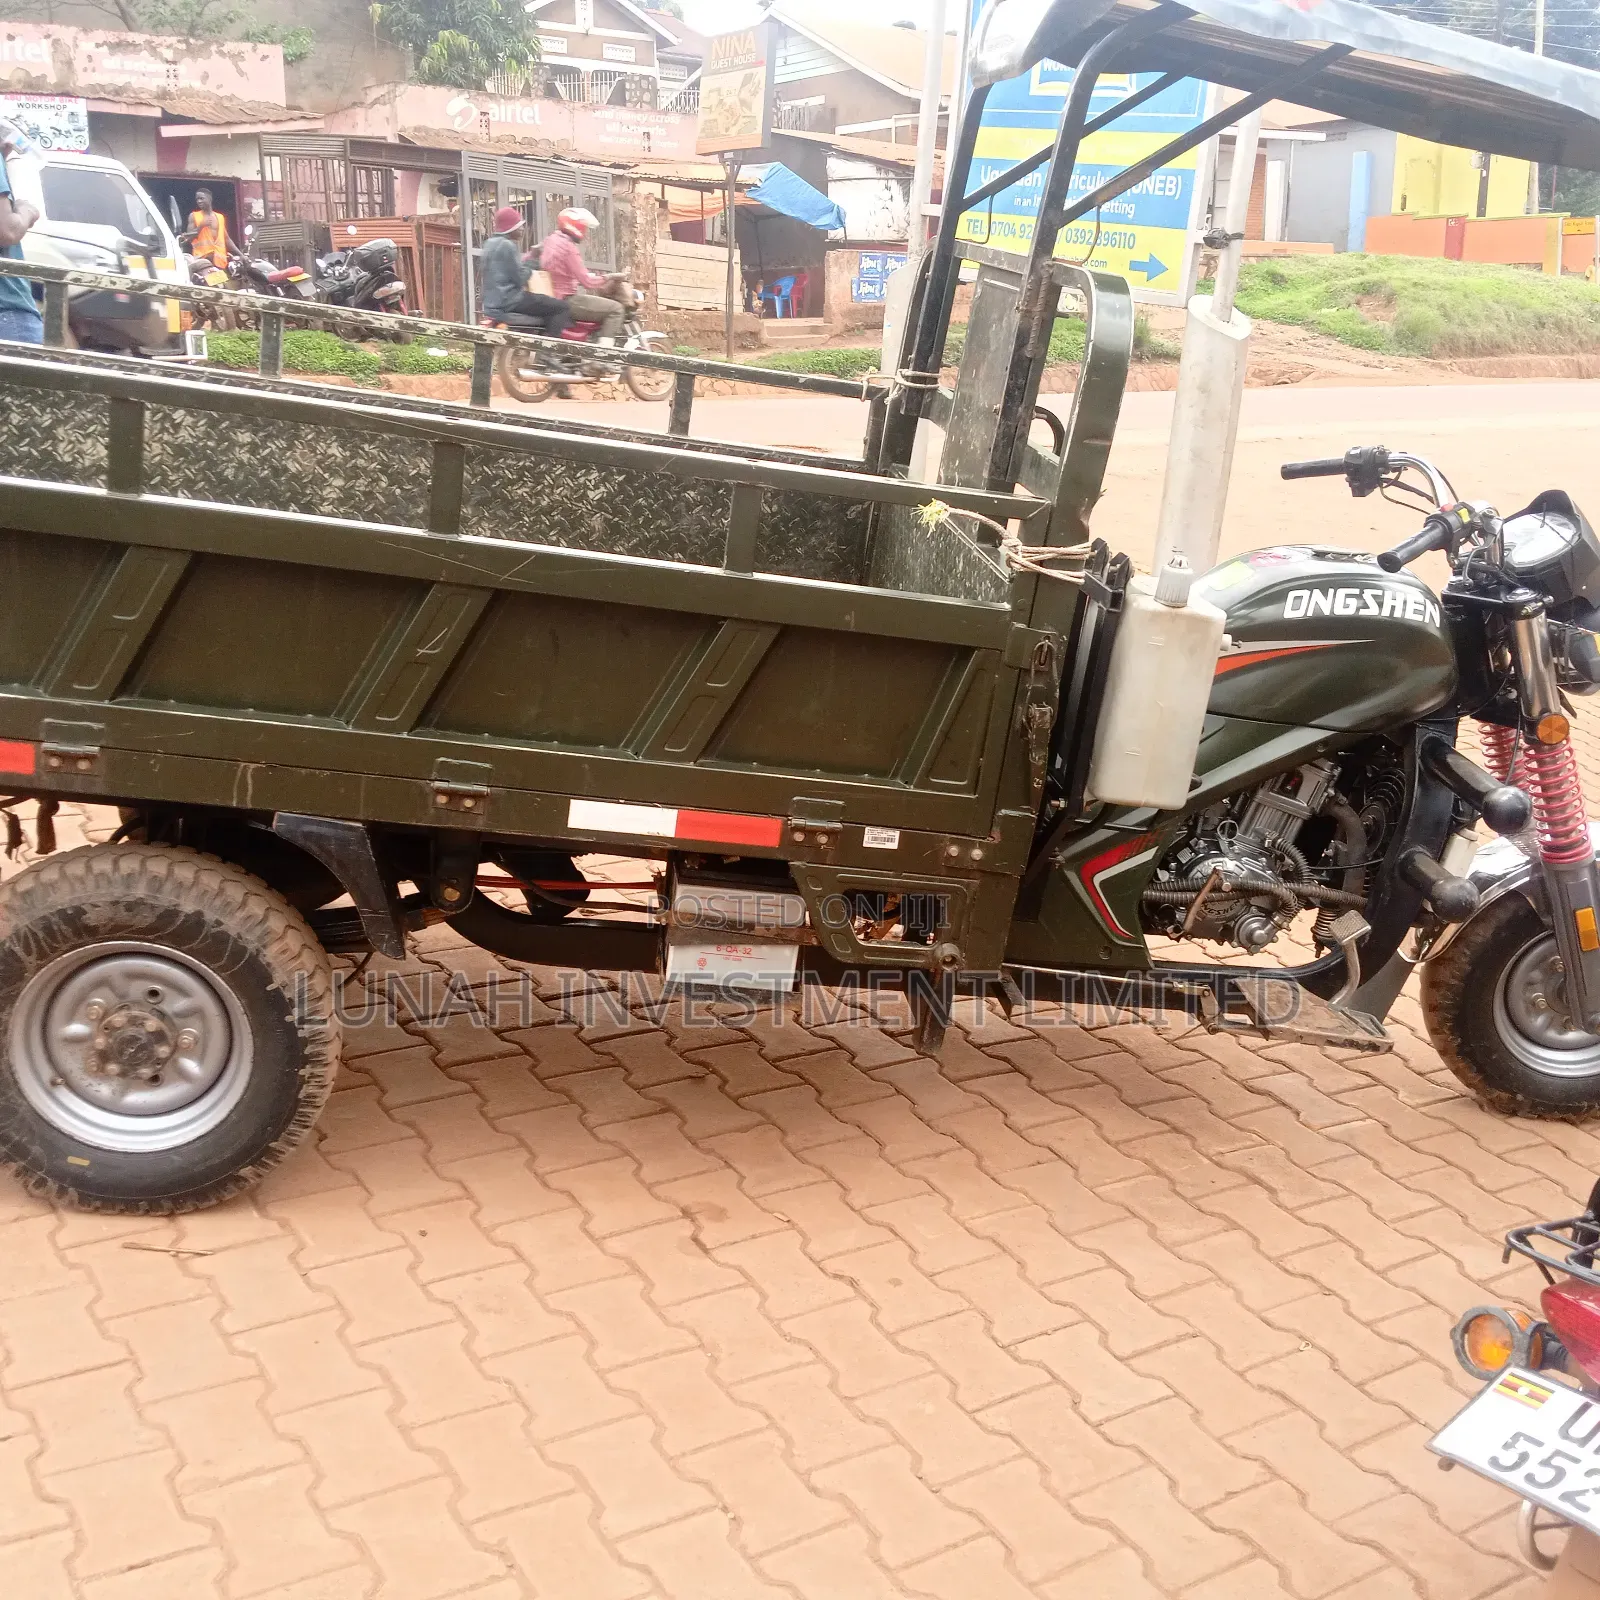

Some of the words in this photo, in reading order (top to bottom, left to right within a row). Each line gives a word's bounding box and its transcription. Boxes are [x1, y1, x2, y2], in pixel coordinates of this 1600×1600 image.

[712, 31, 756, 59] NINA
[711, 58, 732, 70] GUEST
[734, 53, 756, 66] HOUSE
[17, 102, 68, 111] WORKSHOP
[489, 100, 542, 125] airtel
[650, 114, 681, 125] across
[1022, 198, 1031, 207] an
[991, 221, 1016, 238] 0704
[1066, 228, 1093, 246] 0392
[1283, 588, 1441, 628] ONGSHEN
[1558, 1401, 1600, 1455] U
[1487, 1431, 1600, 1513] 552
